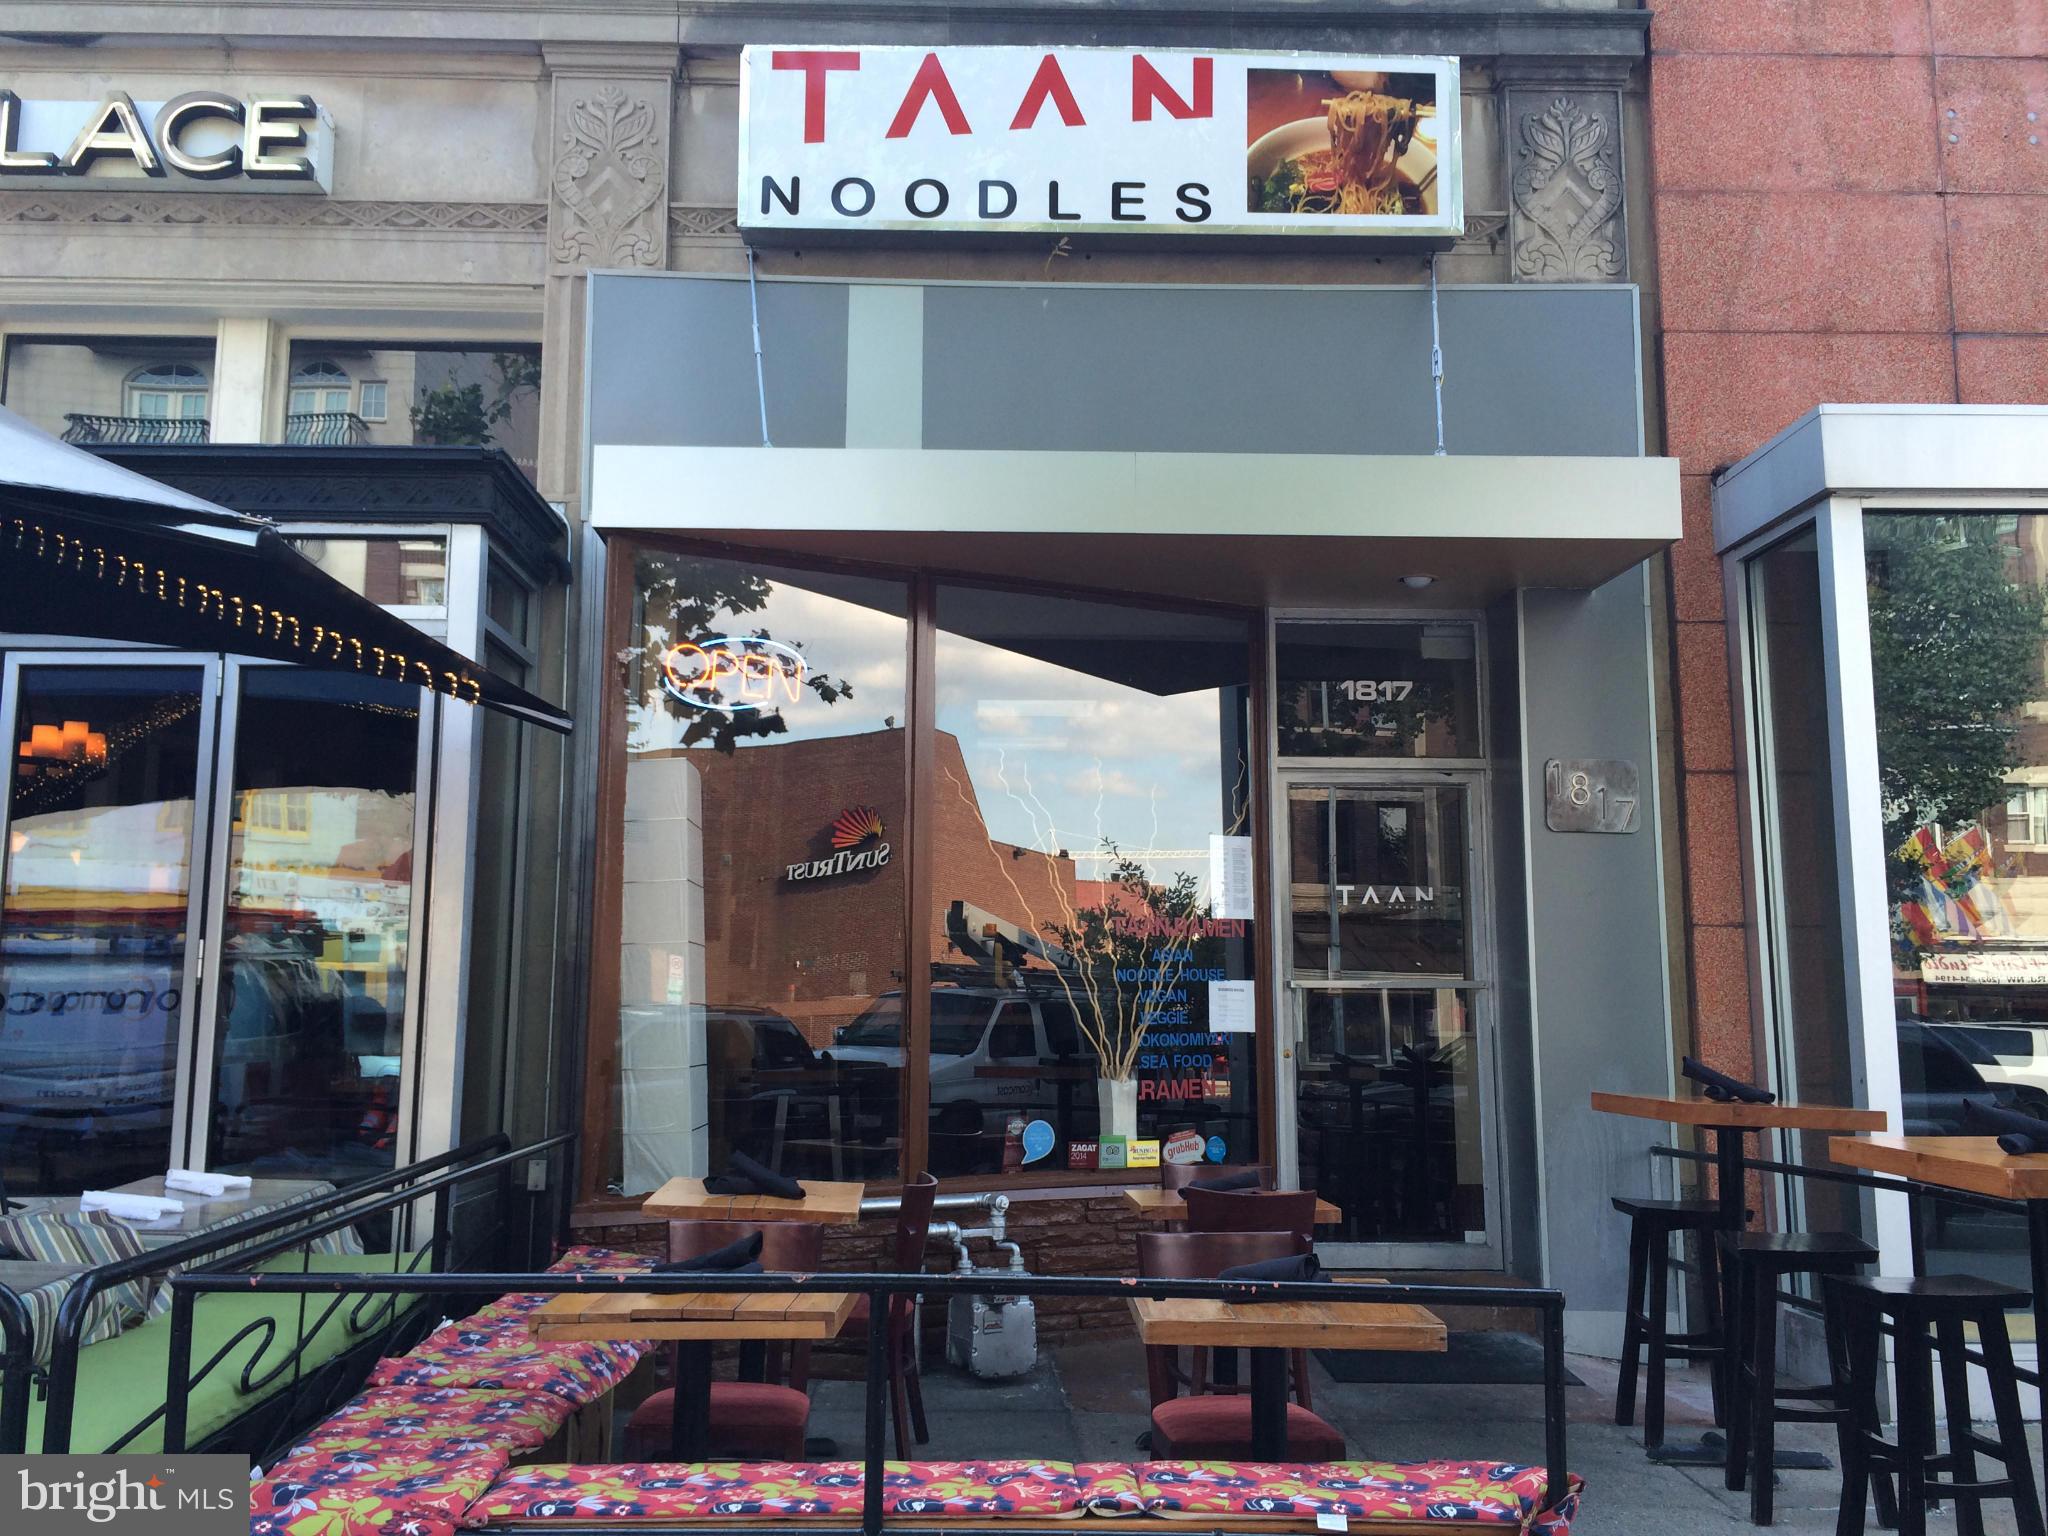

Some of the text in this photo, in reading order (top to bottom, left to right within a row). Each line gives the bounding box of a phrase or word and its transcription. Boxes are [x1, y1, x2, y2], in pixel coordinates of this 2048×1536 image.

[772, 51, 1213, 143] TAAN
[0, 88, 317, 180] LACE
[760, 174, 1213, 223] NOODLES
[666, 643, 803, 703] OPEN
[1338, 680, 1413, 701] 1817
[1548, 761, 1636, 832] 1817
[1336, 885, 1433, 906] TAAN
[1151, 949, 1193, 962] ASIAN
[1117, 968, 1175, 982] NOODLE
[1174, 1054, 1213, 1068] FOOD
[1070, 1151, 1087, 1160] 2014
[1071, 1143, 1098, 1152] ZAGAT
